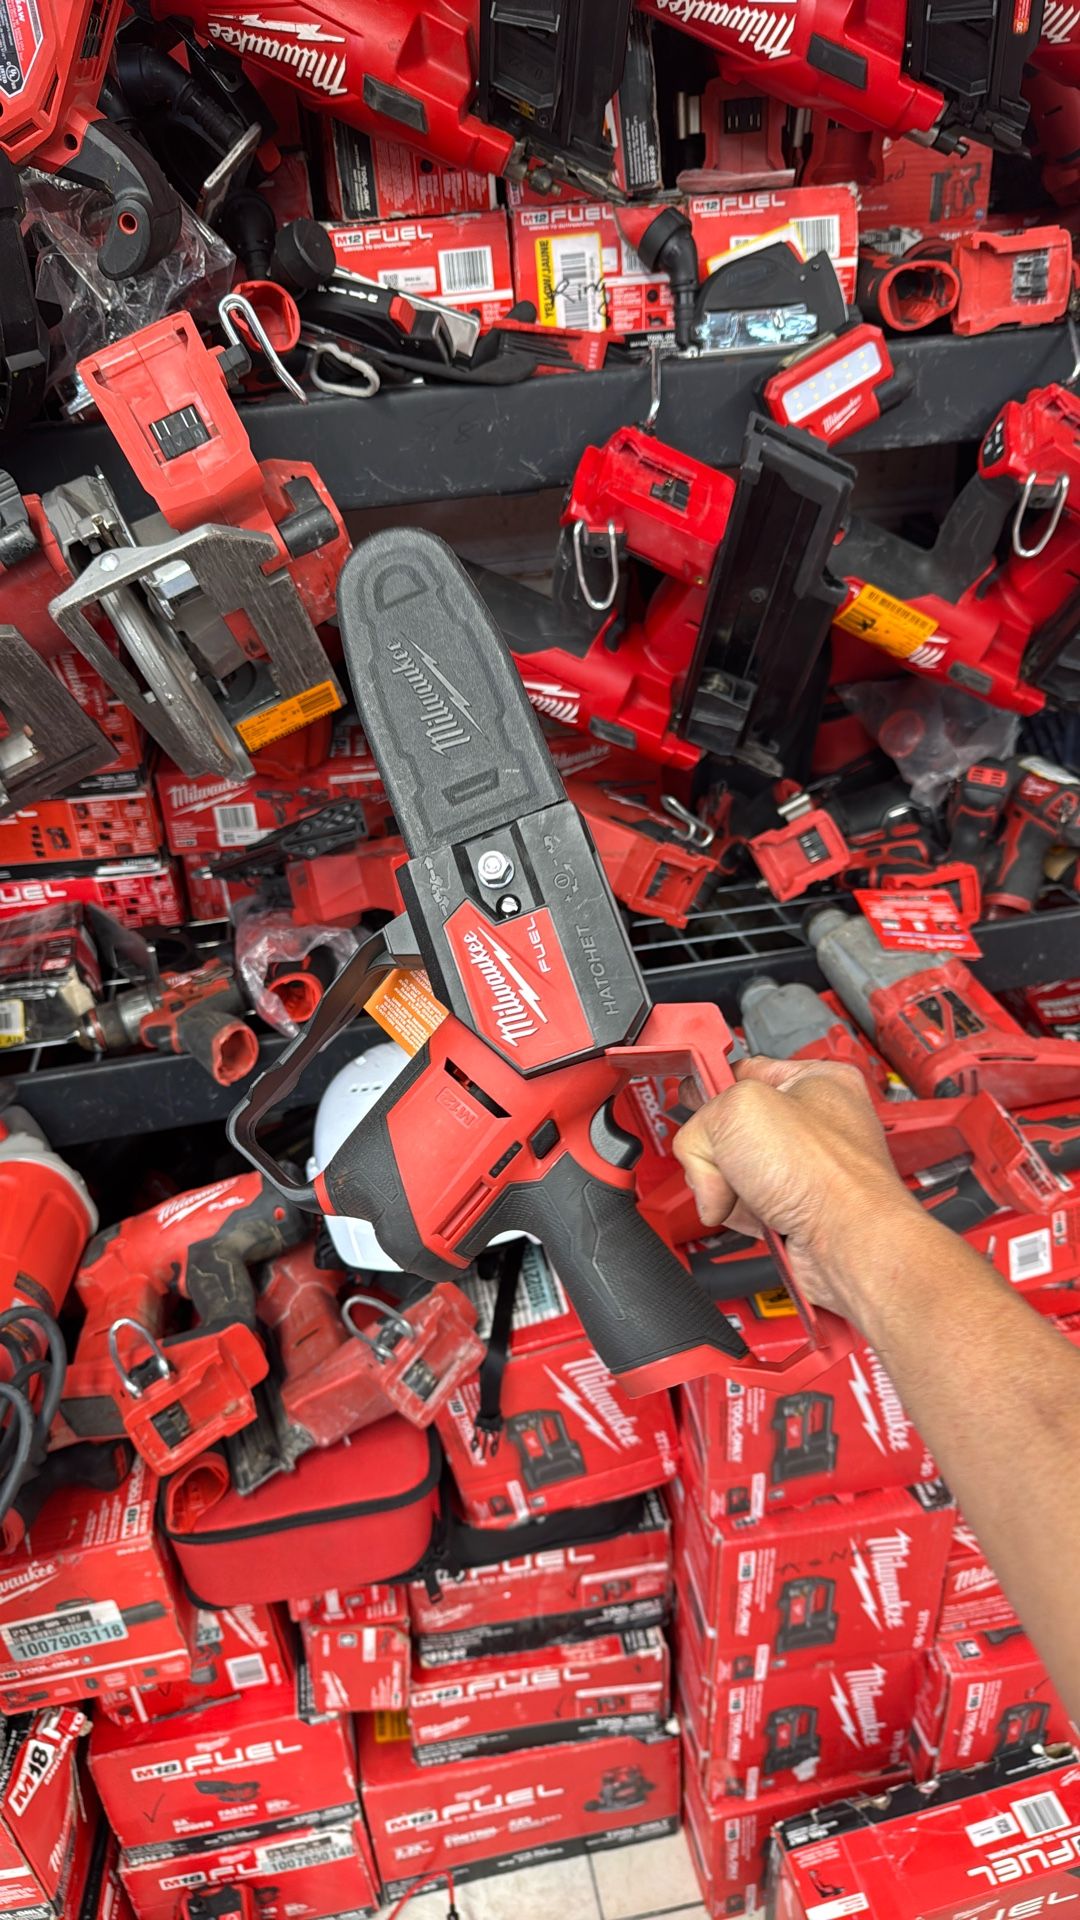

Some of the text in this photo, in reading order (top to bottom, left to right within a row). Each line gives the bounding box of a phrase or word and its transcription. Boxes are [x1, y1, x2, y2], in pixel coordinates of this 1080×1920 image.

[207, 22, 348, 96] Milwaukee
[522, 206, 615, 226] M12 FUEL
[694, 193, 786, 212] M12 FUEL
[335, 225, 434, 247] M12 FUEL
[386, 640, 472, 760] Milwaukee
[527, 916, 552, 973] FUEL
[463, 930, 540, 1047] Milwaukee
[576, 924, 620, 1016] HATCHET
[562, 1349, 643, 1450] Milwaukee
[866, 1528, 913, 1630] Milwaukee
[18, 1623, 124, 1659] 1007903118
[467, 1667, 590, 1697] FUEL
[844, 1662, 889, 1748] Milwaukee
[69, 1712, 85, 1732] TO
[12, 1745, 50, 1810] M18
[133, 1739, 303, 1781] M18 FUEL
[386, 1784, 565, 1832] M18 FUEL
[161, 1872, 206, 1889] M18
[966, 1839, 1076, 1886] FUEL
